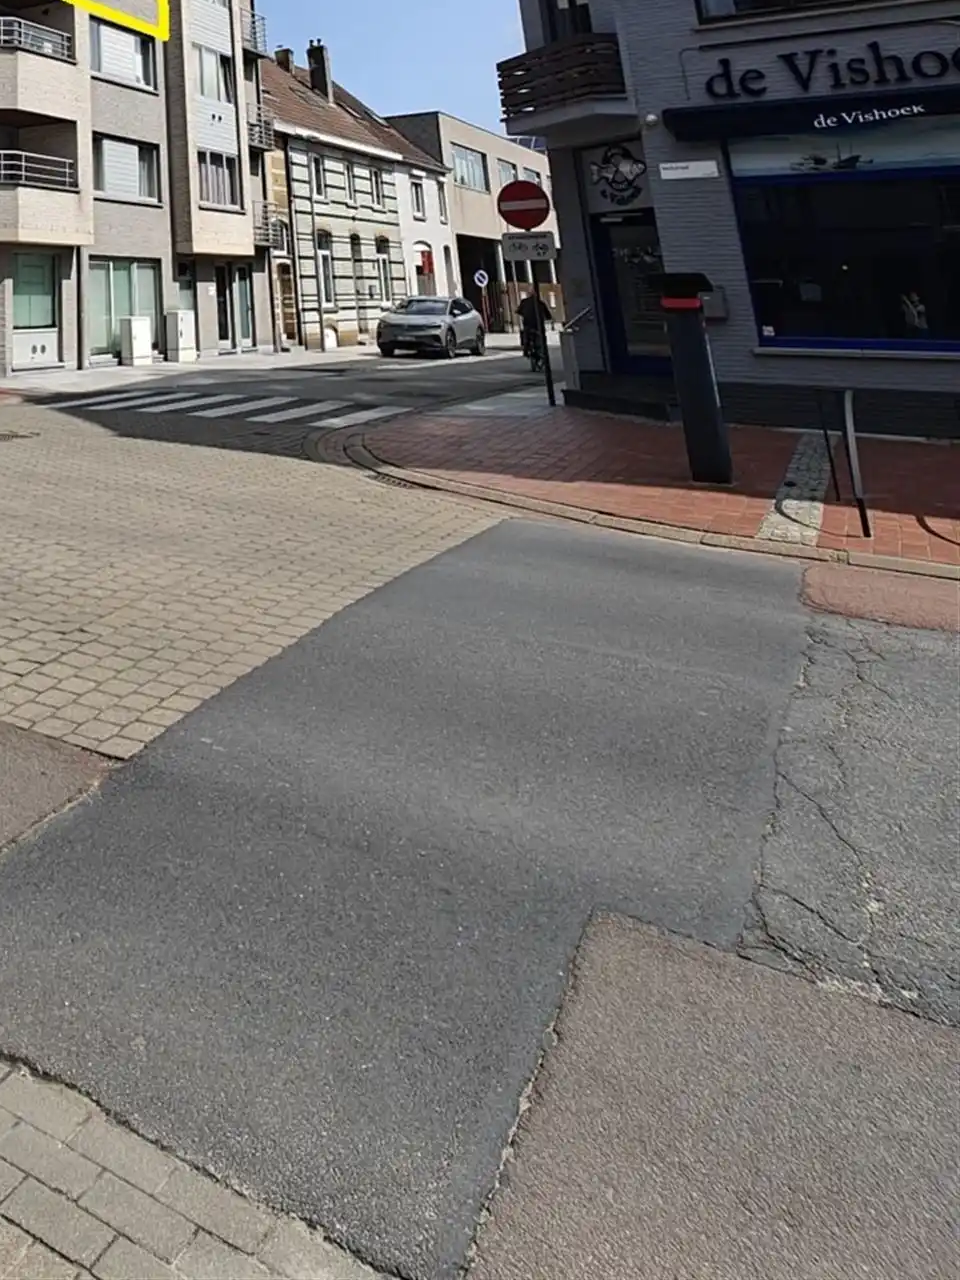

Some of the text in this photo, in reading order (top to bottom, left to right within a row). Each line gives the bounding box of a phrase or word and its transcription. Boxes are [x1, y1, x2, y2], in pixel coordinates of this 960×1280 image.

[704, 58, 768, 100] de
[814, 104, 926, 129] de Vishoek
